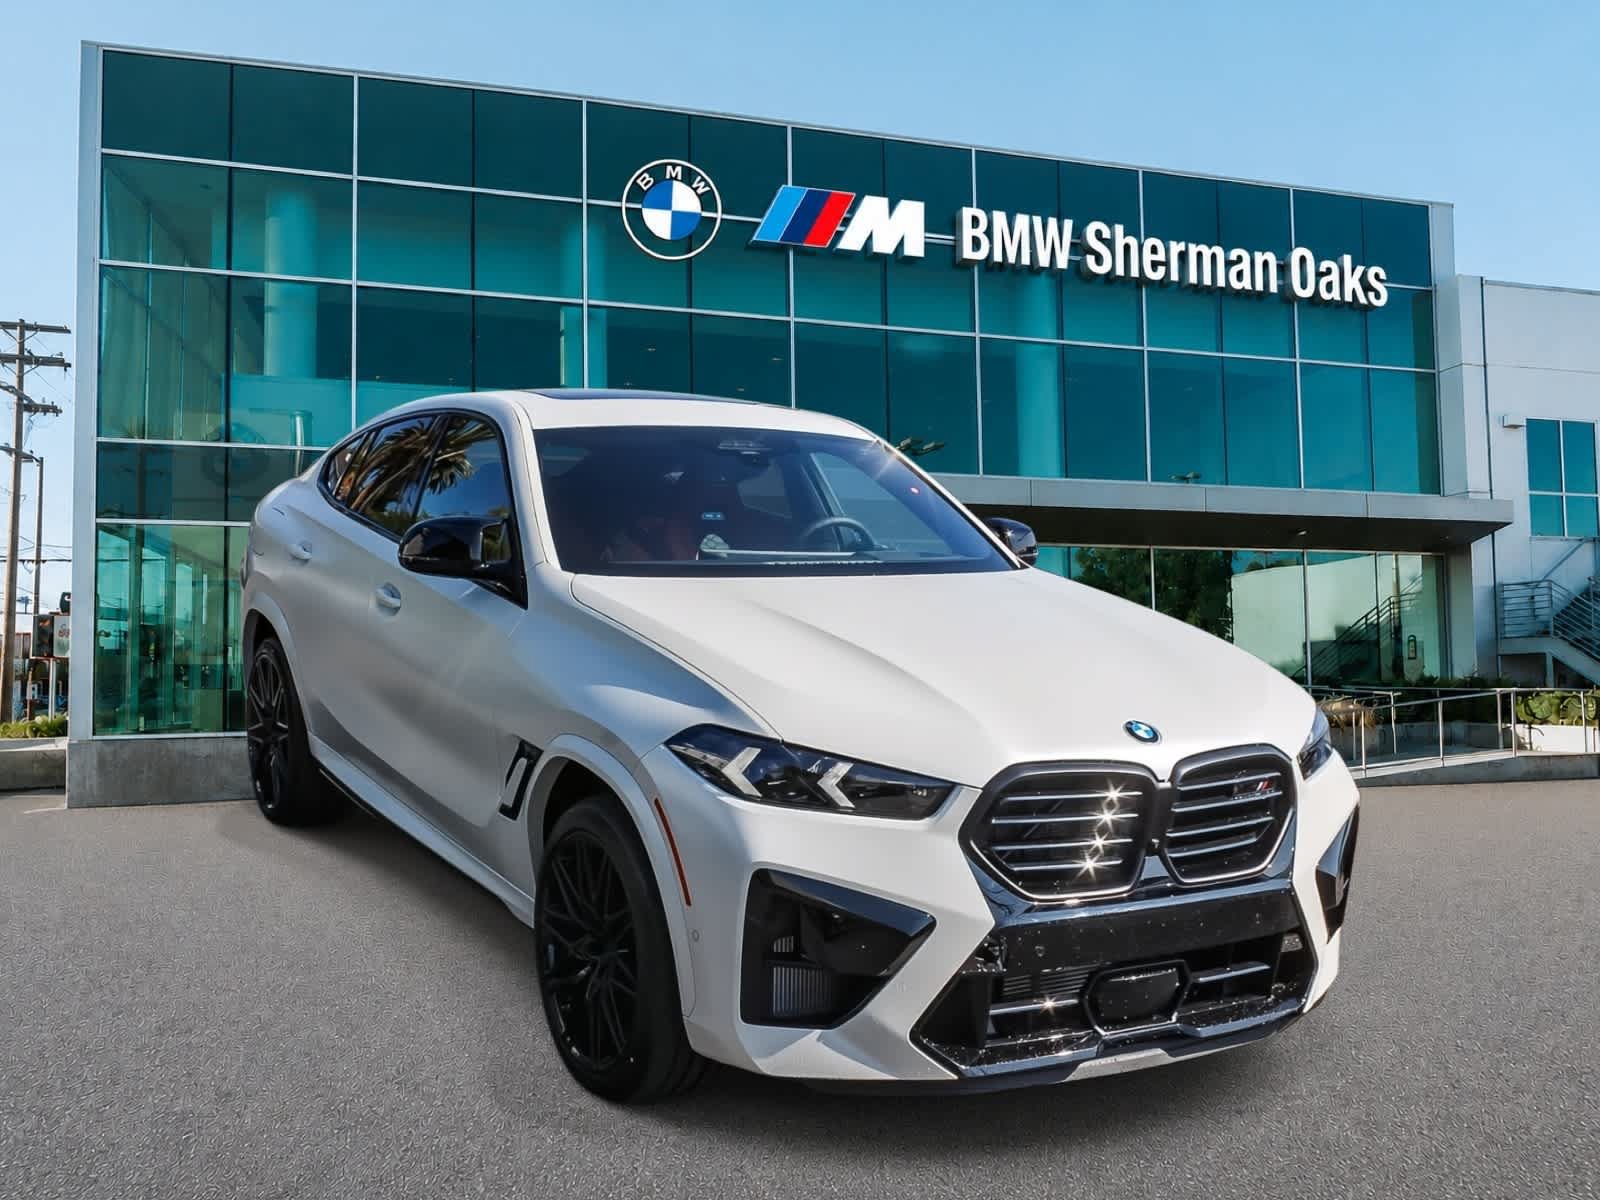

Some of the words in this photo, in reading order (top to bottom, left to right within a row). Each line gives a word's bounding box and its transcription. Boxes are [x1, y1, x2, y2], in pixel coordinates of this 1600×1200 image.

[636, 165, 711, 195] BMW
[834, 194, 925, 257] M
[960, 206, 1073, 270] BMW
[1084, 220, 1278, 293] Sherman
[1289, 246, 1388, 307] Oaks
